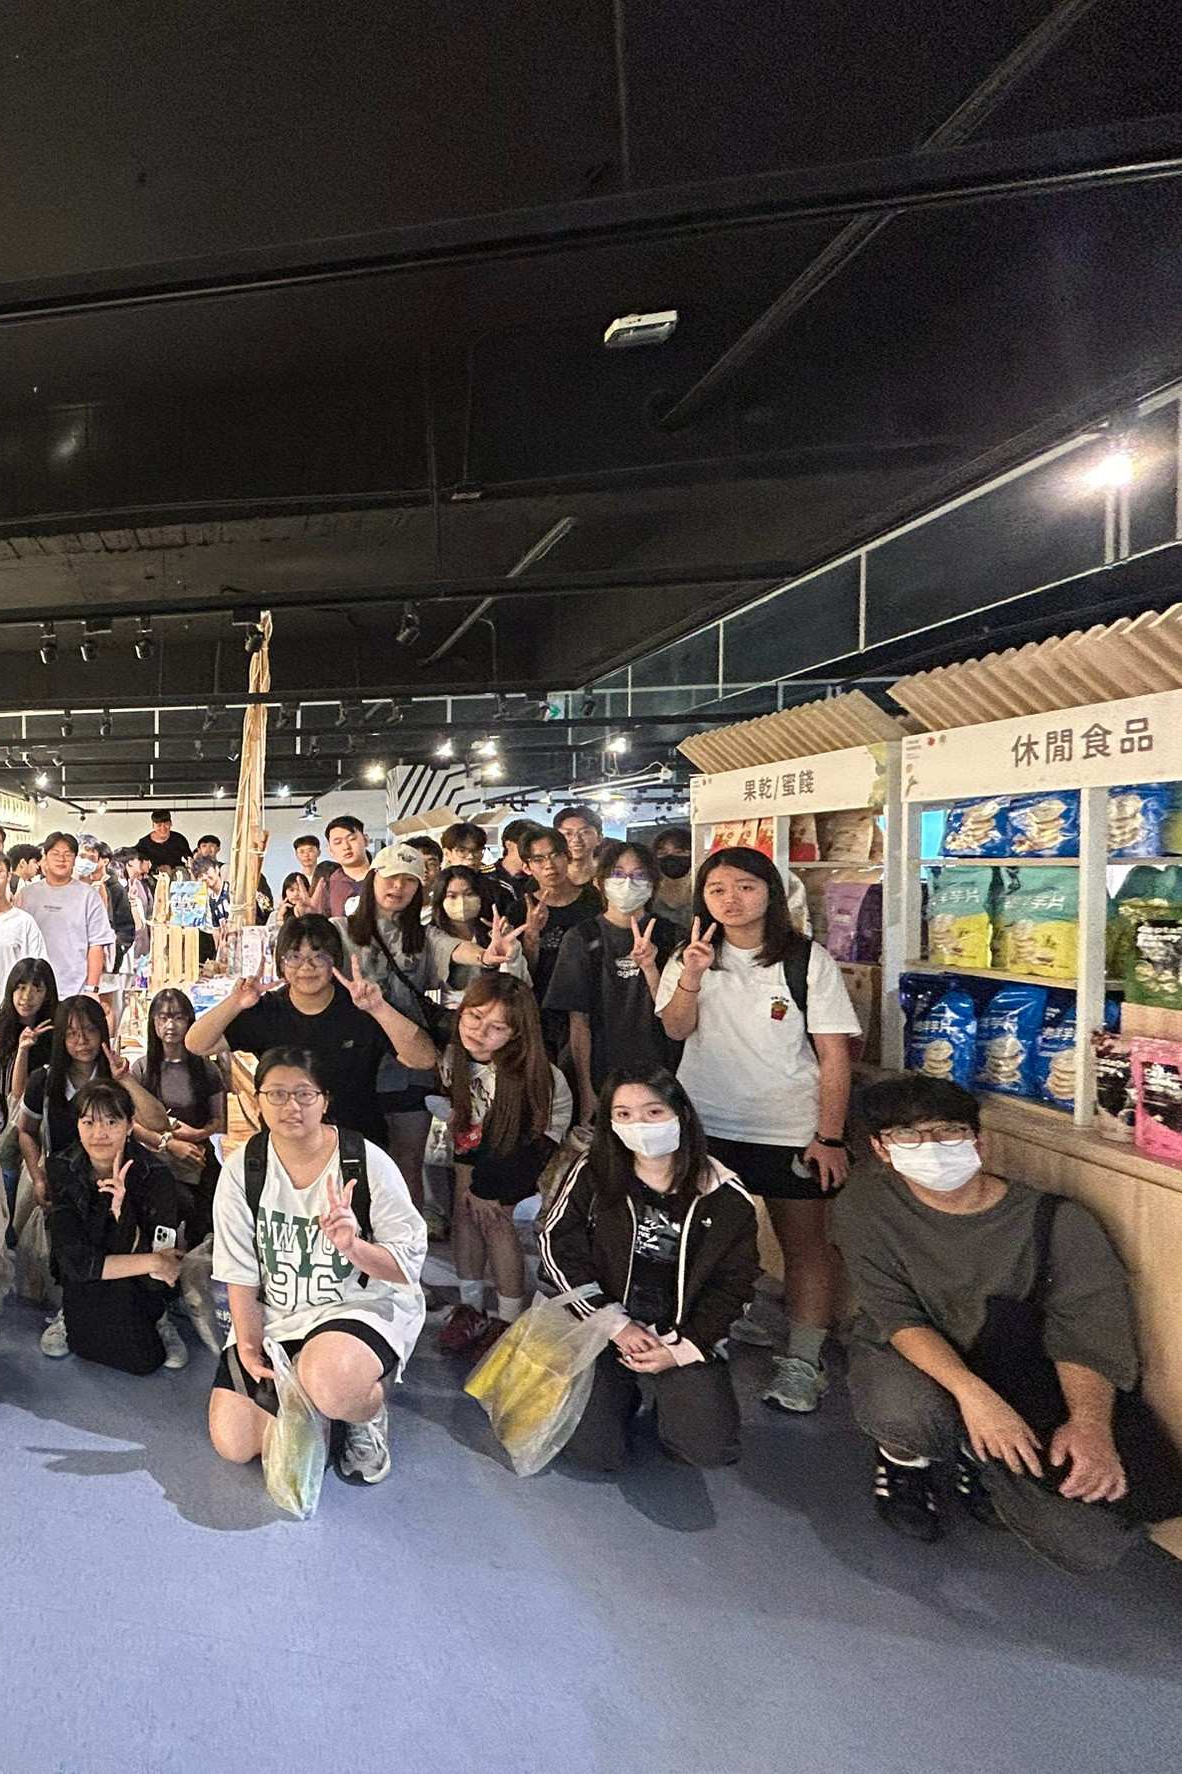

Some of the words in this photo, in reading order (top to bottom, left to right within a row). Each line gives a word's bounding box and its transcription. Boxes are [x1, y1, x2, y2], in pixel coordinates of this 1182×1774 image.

[1011, 717, 1154, 768] 休閒食品
[743, 769, 815, 802] 果乾/蜜餞
